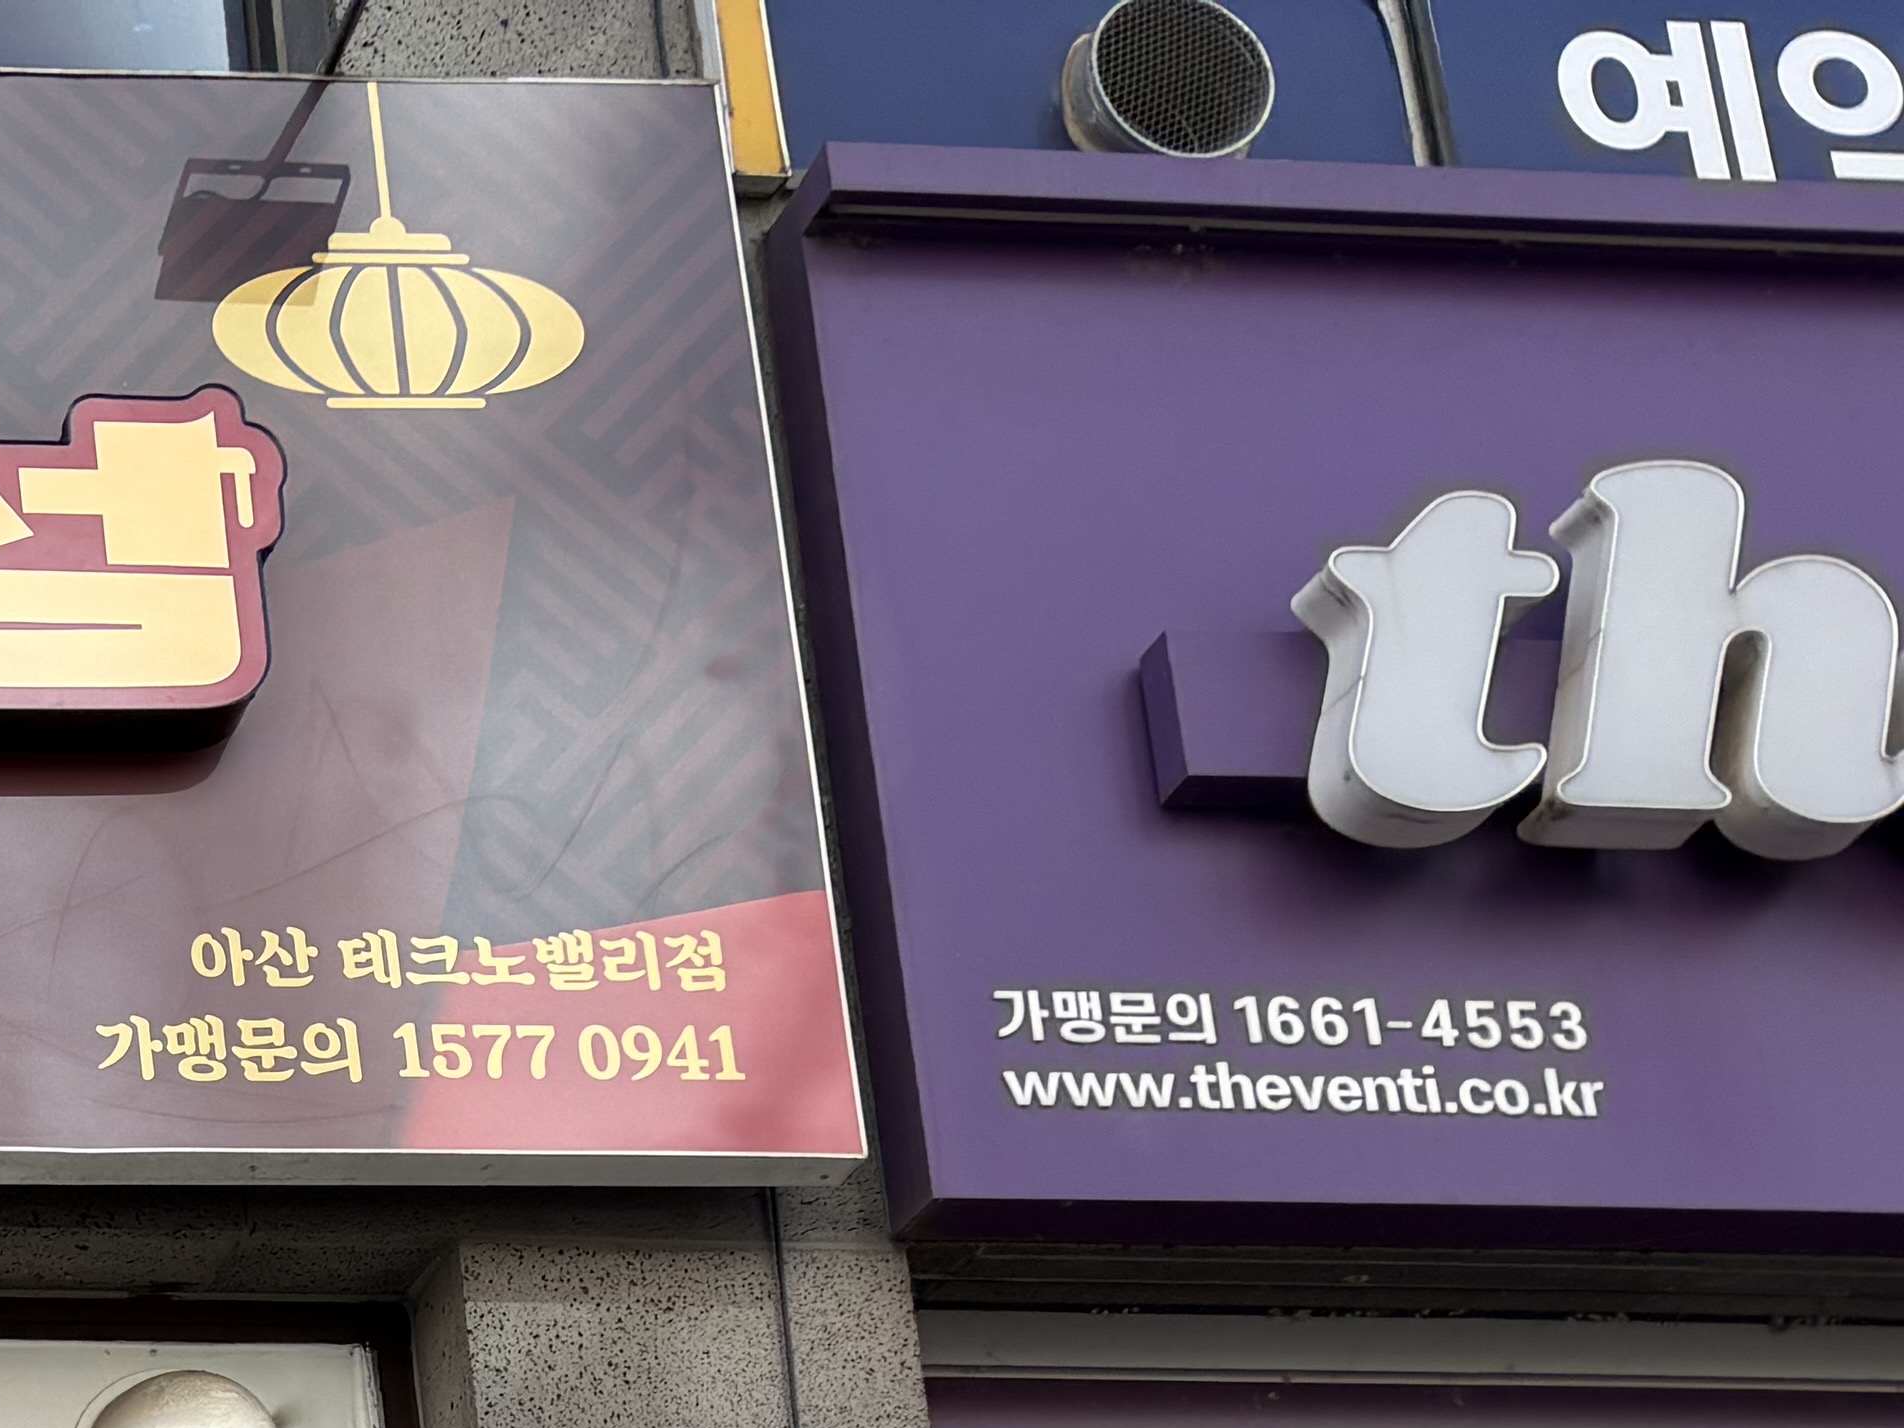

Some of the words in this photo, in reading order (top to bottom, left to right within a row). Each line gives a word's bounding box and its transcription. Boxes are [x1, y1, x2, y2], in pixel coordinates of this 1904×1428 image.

[191, 927, 318, 988] 아산
[338, 929, 726, 993] 테크노밸리점
[96, 1015, 363, 1083] 가맹문의
[393, 1024, 557, 1081] 1577
[577, 1024, 746, 1081] 0941
[993, 990, 1218, 1046] 가맹문의
[1233, 995, 1588, 1052] 1661-4553
[1003, 1061, 1605, 1117] www.theventi.co.kr
